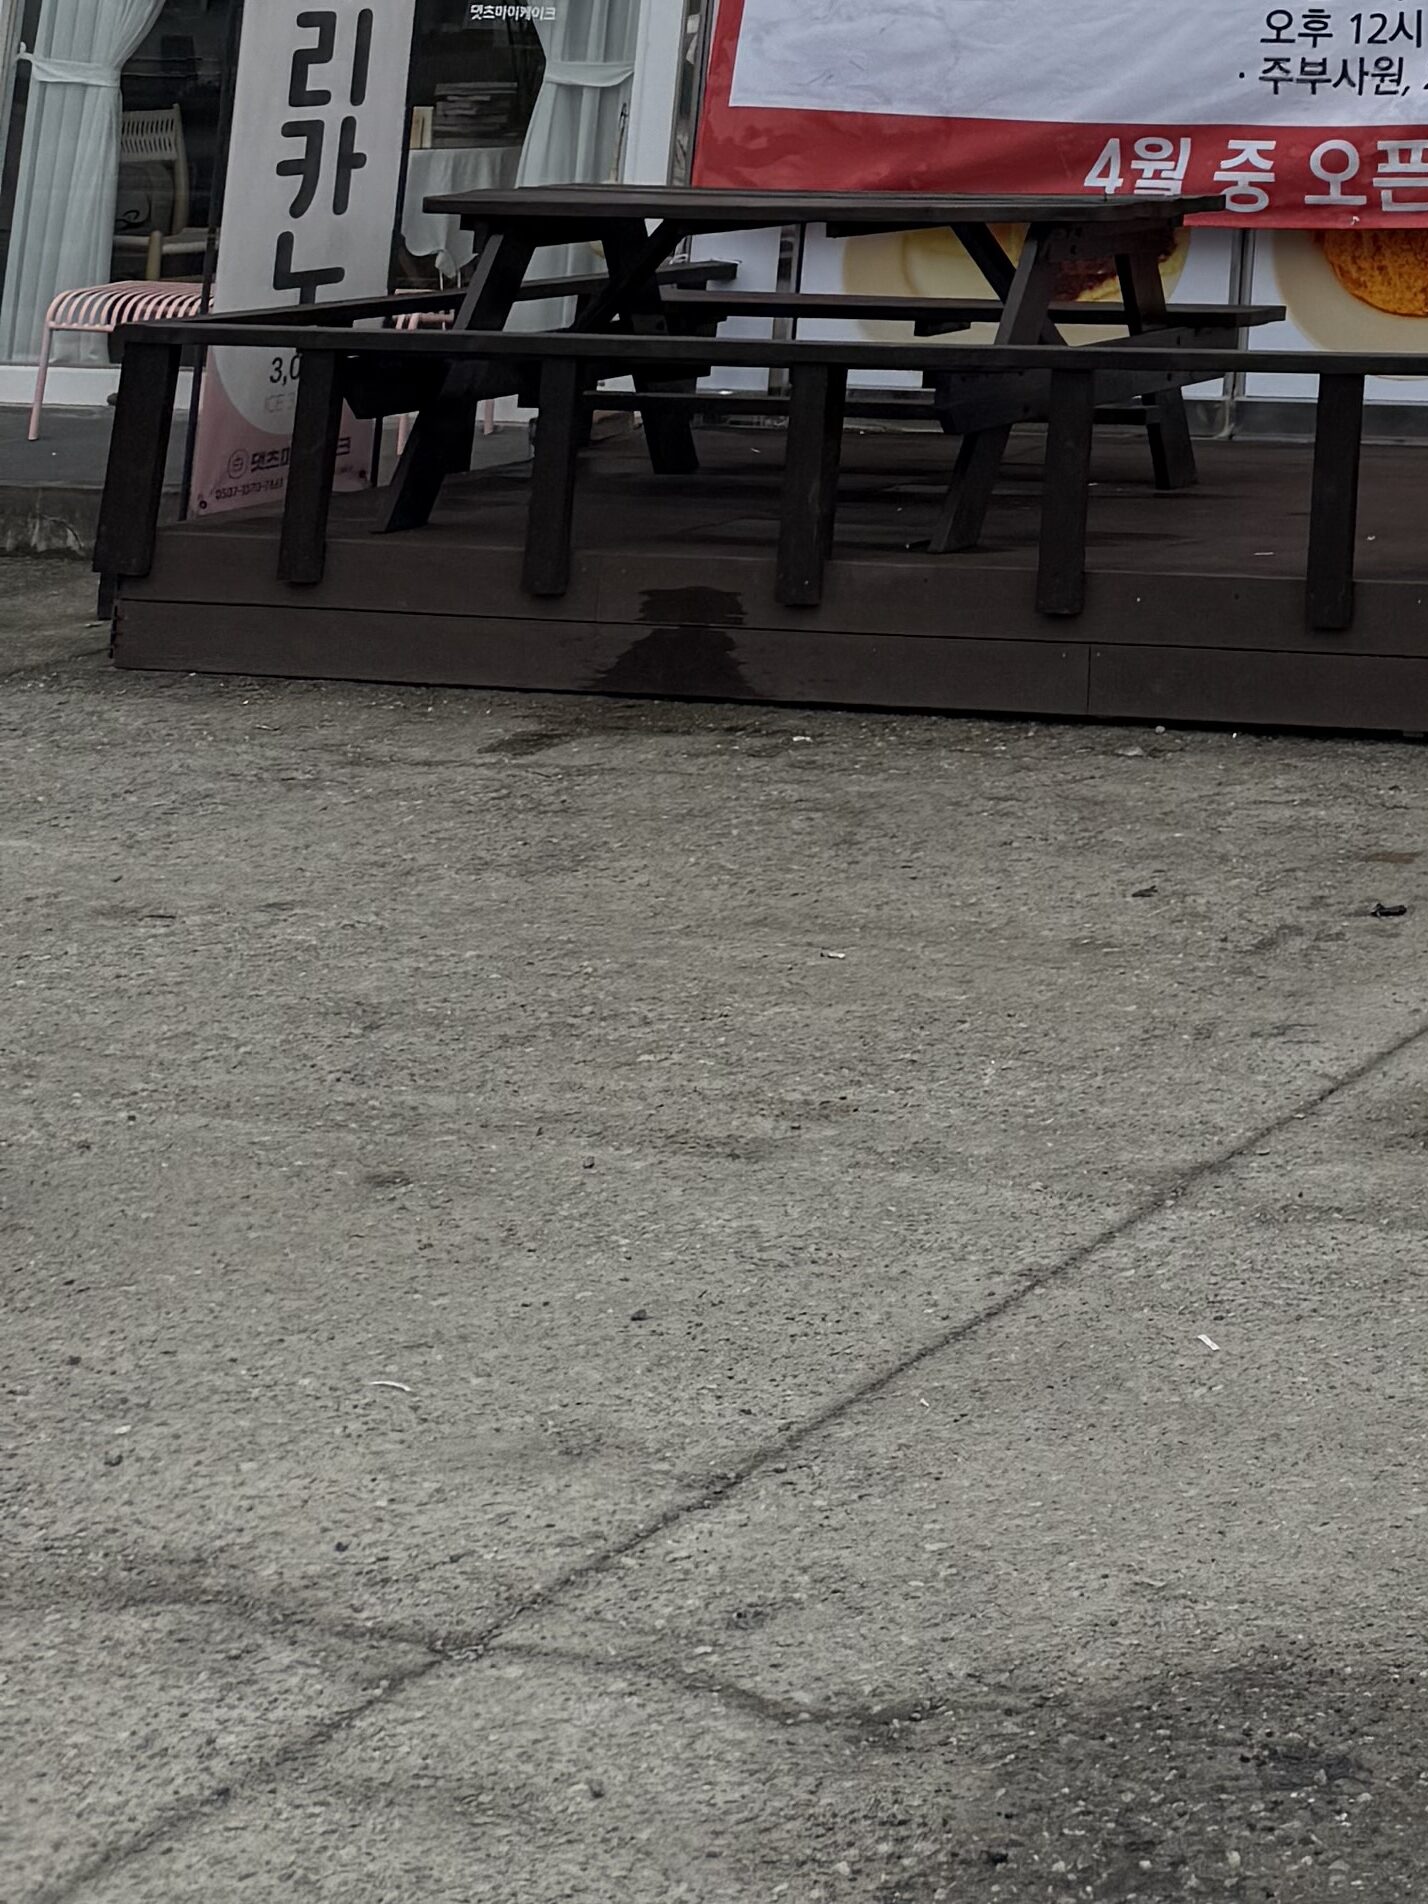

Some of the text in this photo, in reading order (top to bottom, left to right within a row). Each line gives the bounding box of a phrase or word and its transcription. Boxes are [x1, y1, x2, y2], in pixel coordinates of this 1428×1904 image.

[1260, 9, 1333, 48] 오후
[1351, 10, 1422, 48] 12시
[1259, 56, 1410, 96] 주부사원,
[1084, 137, 1191, 195] 4월
[1213, 140, 1276, 212] 중
